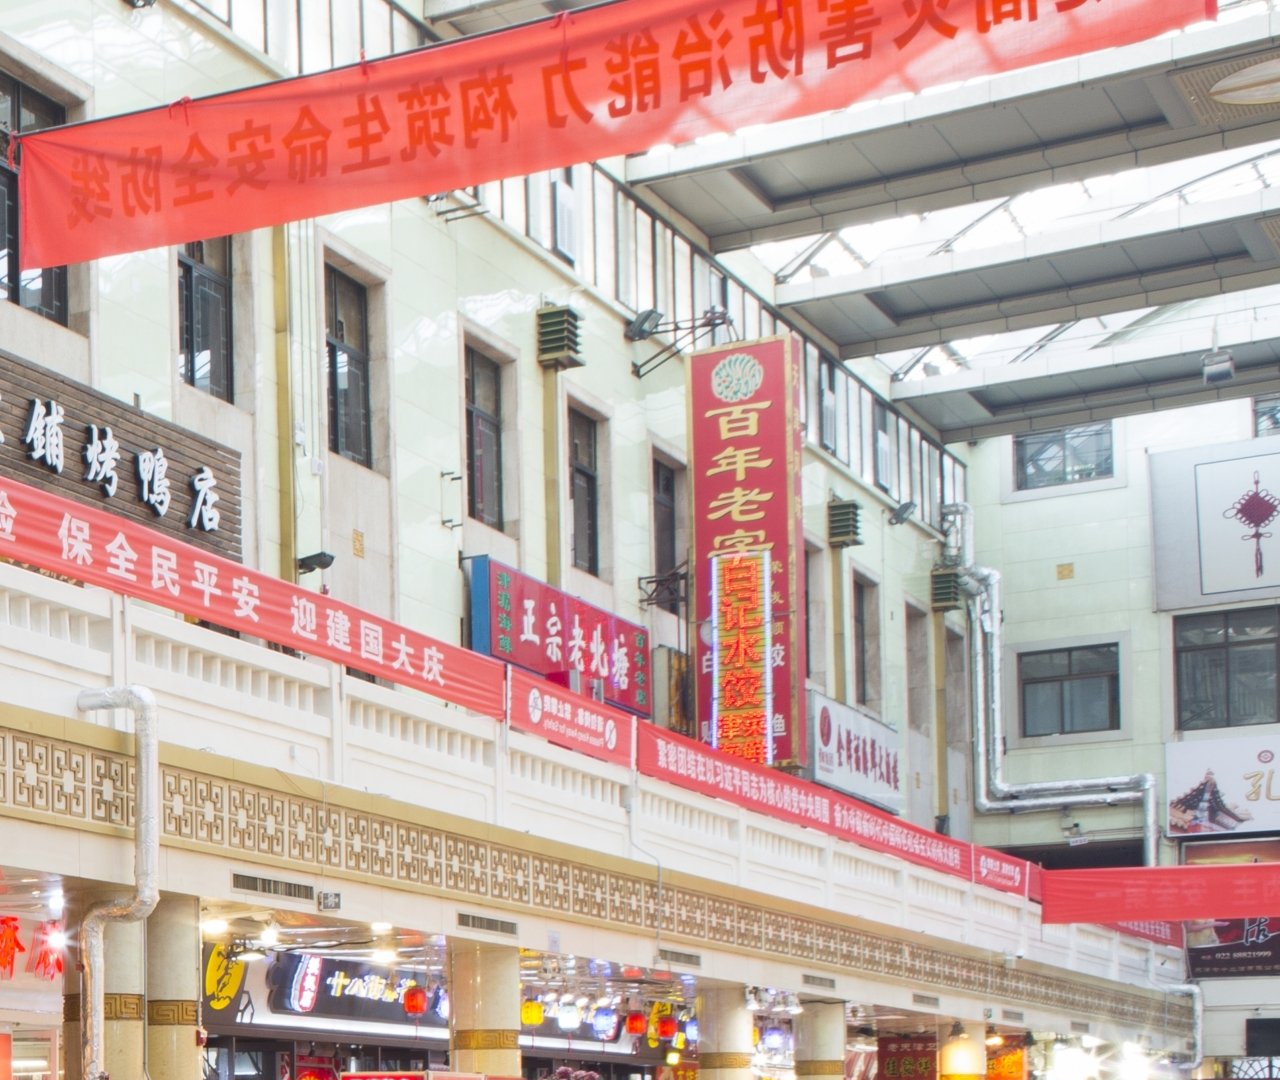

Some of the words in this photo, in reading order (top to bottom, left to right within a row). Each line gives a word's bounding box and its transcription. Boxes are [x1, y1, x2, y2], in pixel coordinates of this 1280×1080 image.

[59, 512, 262, 624] 保全民平安
[291, 594, 446, 687] 迎建国大庆
